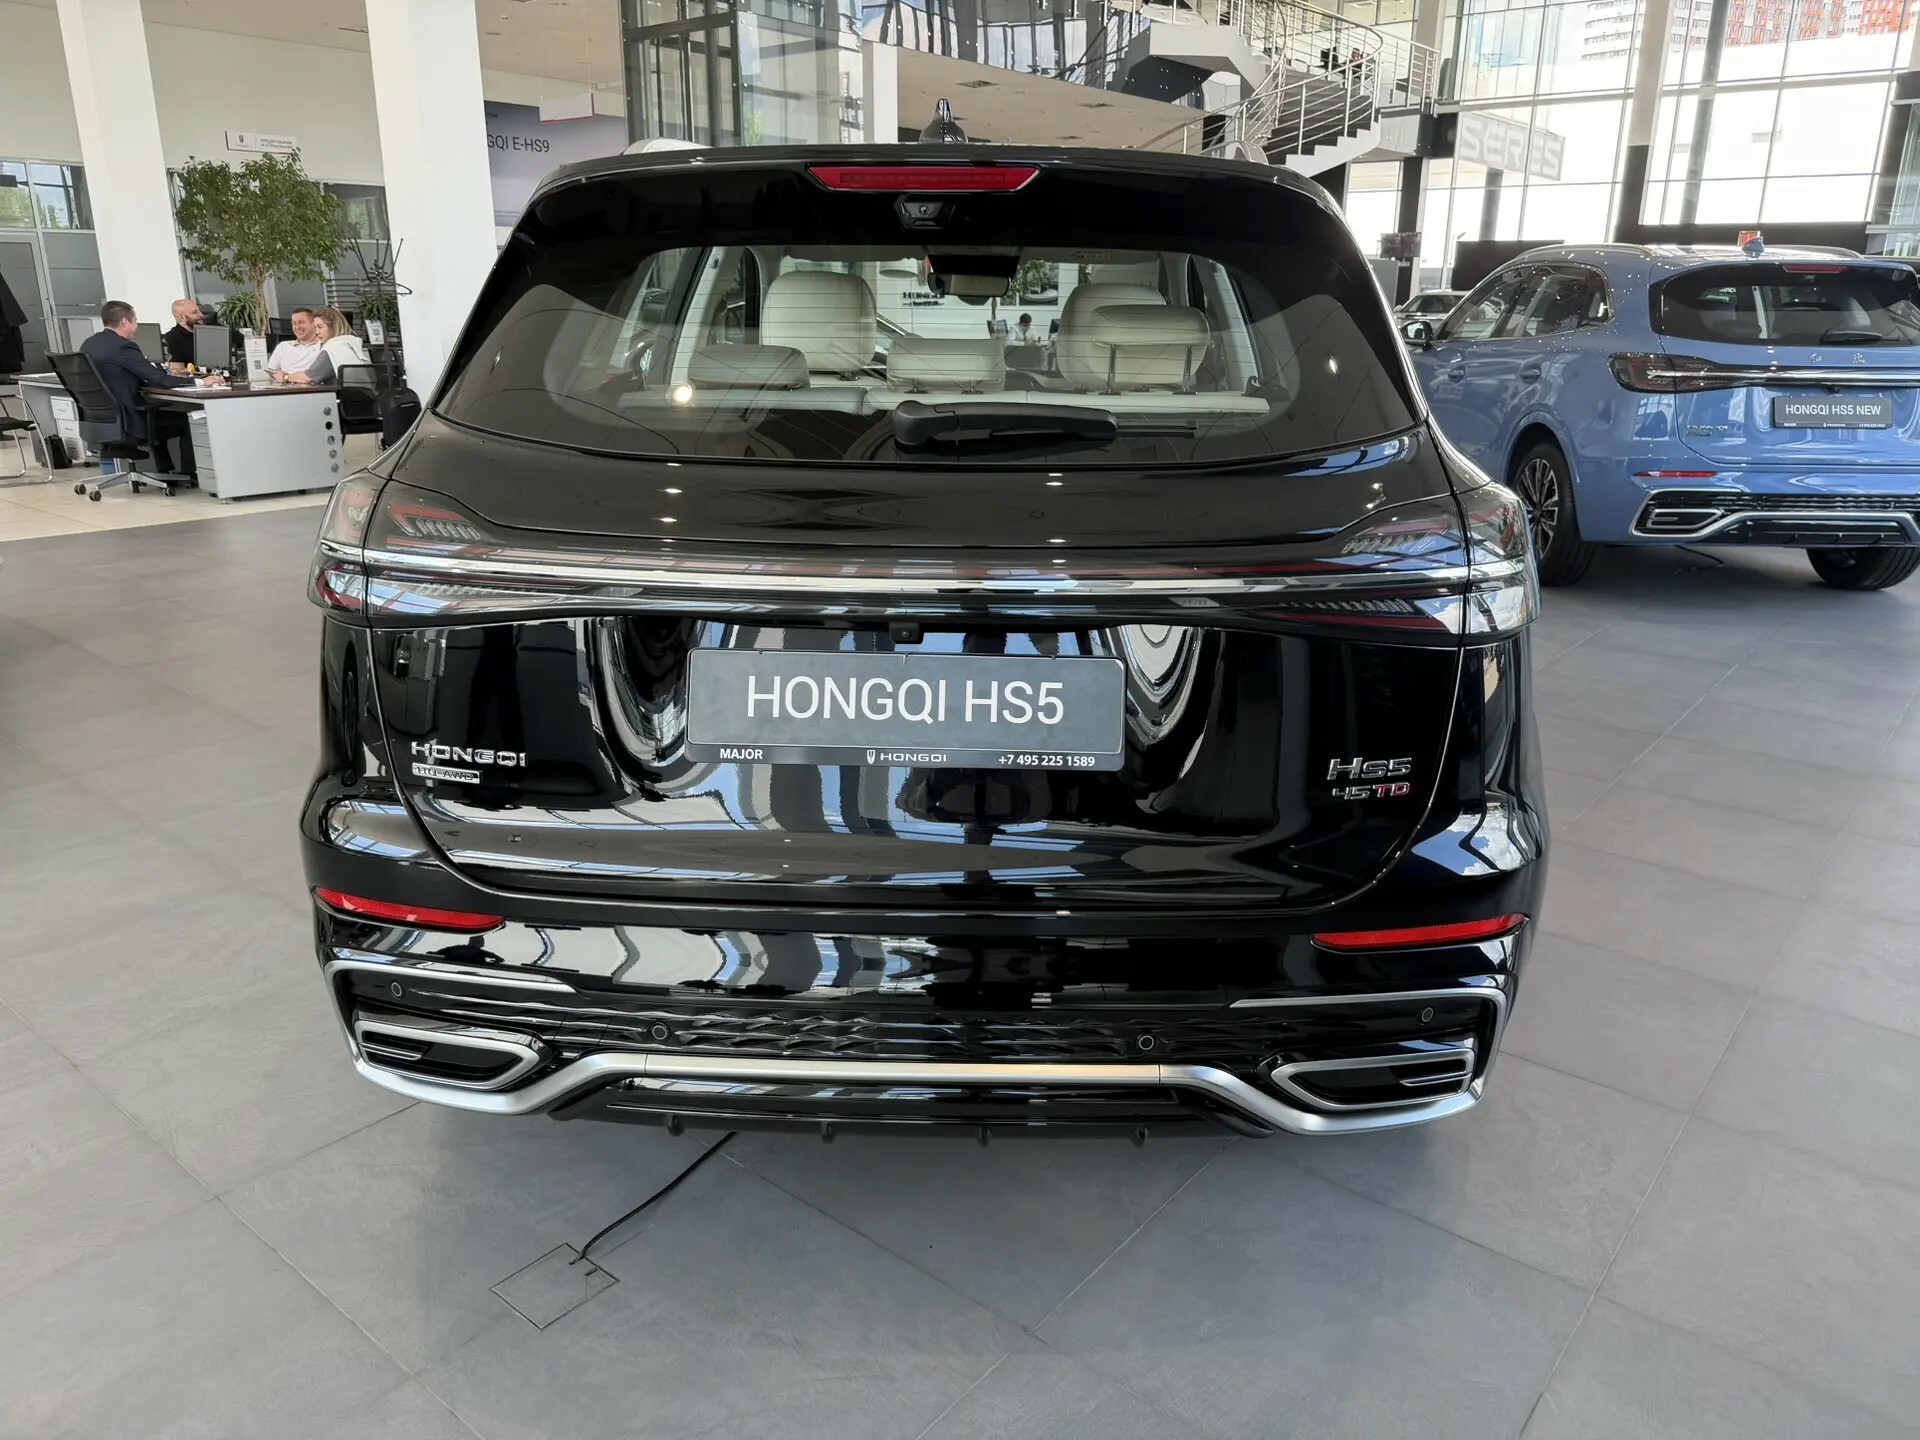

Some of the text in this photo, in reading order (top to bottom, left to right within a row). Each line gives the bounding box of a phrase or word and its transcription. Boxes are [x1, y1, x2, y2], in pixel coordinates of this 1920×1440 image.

[512, 137, 550, 153] E-HS9
[1459, 117, 1561, 177] SERES
[1785, 404, 1881, 416] HONGQI HS5 NEW
[748, 675, 1065, 725] HONGQI HS5
[411, 741, 527, 767] HONGQI
[719, 748, 764, 761] MAJOR
[880, 752, 948, 763] HONGQI
[998, 755, 1096, 767] +7 495 225 1589
[1332, 782, 1410, 800] 45TD
